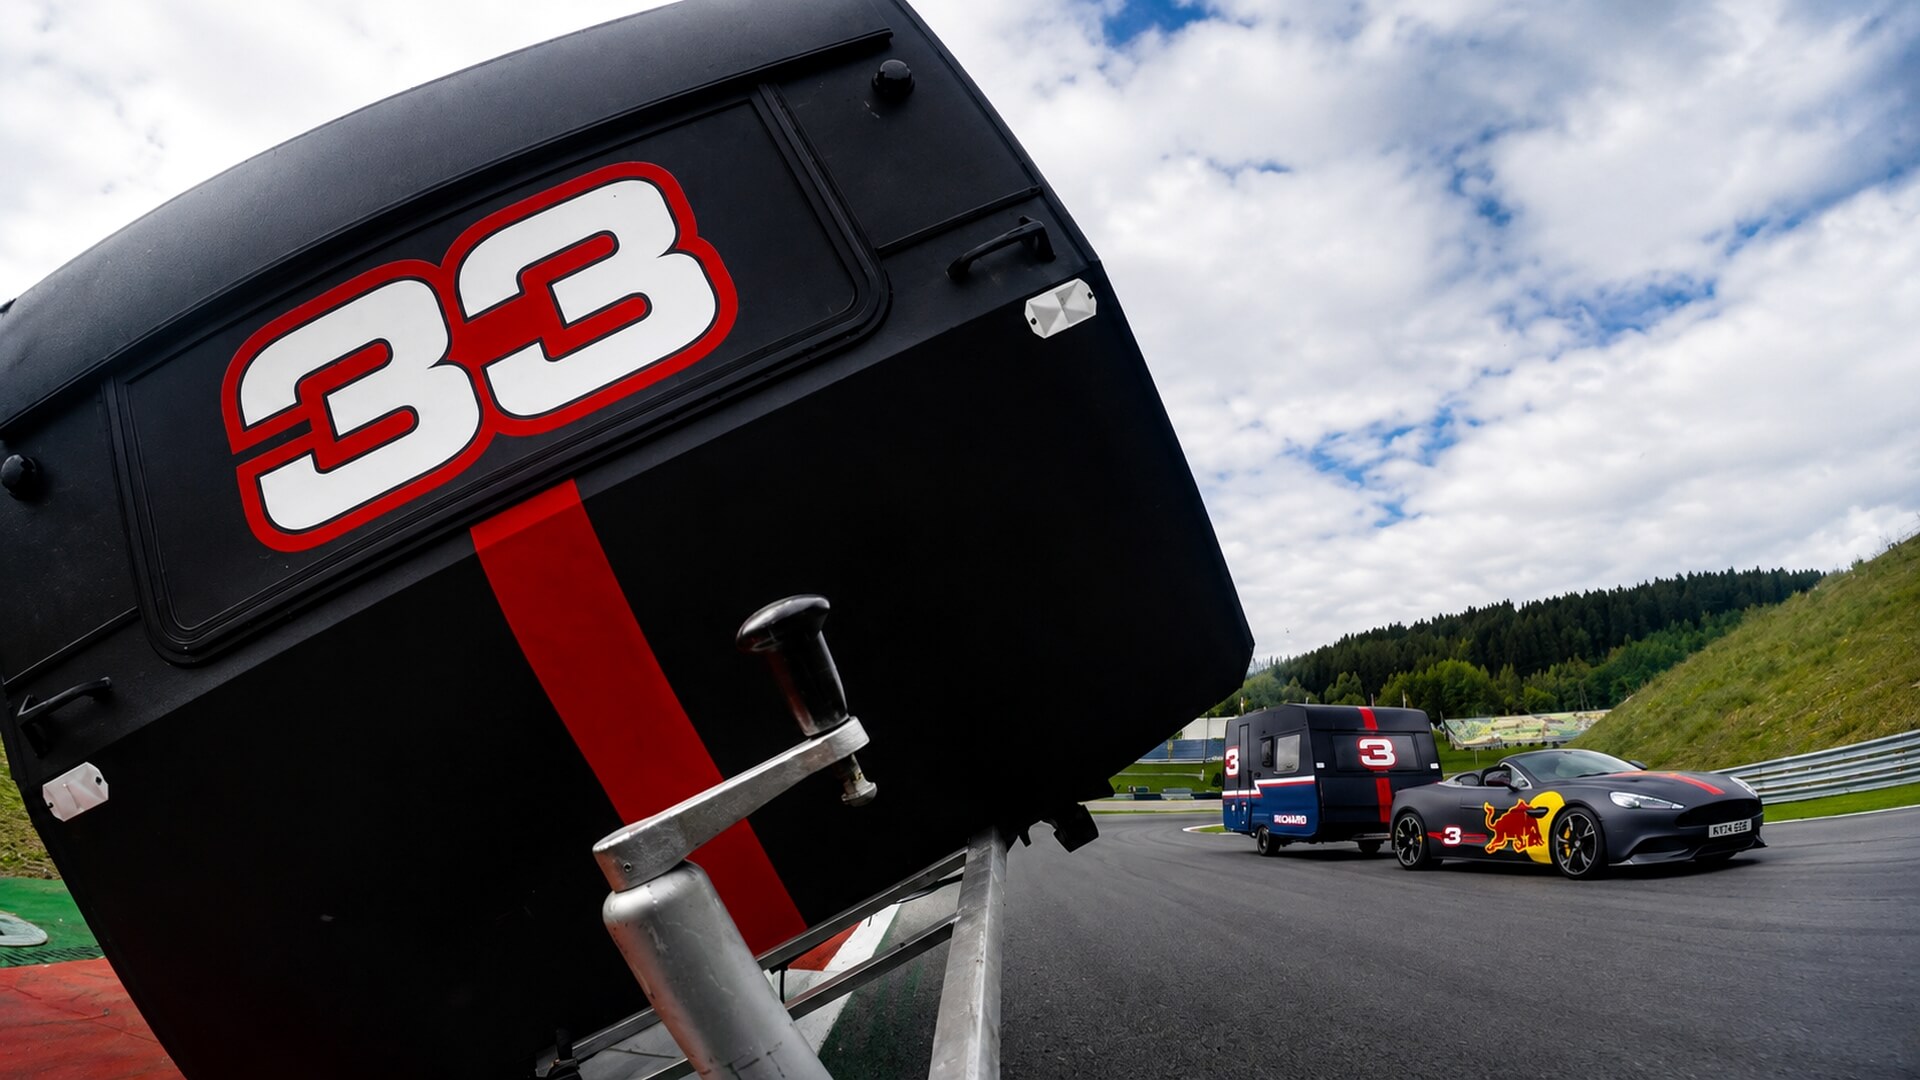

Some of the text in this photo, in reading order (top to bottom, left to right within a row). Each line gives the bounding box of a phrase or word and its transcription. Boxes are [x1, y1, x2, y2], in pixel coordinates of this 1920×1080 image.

[238, 178, 718, 533] 33
[1225, 747, 1240, 777] 3
[1358, 737, 1397, 767] 3
[1443, 826, 1462, 845] 3
